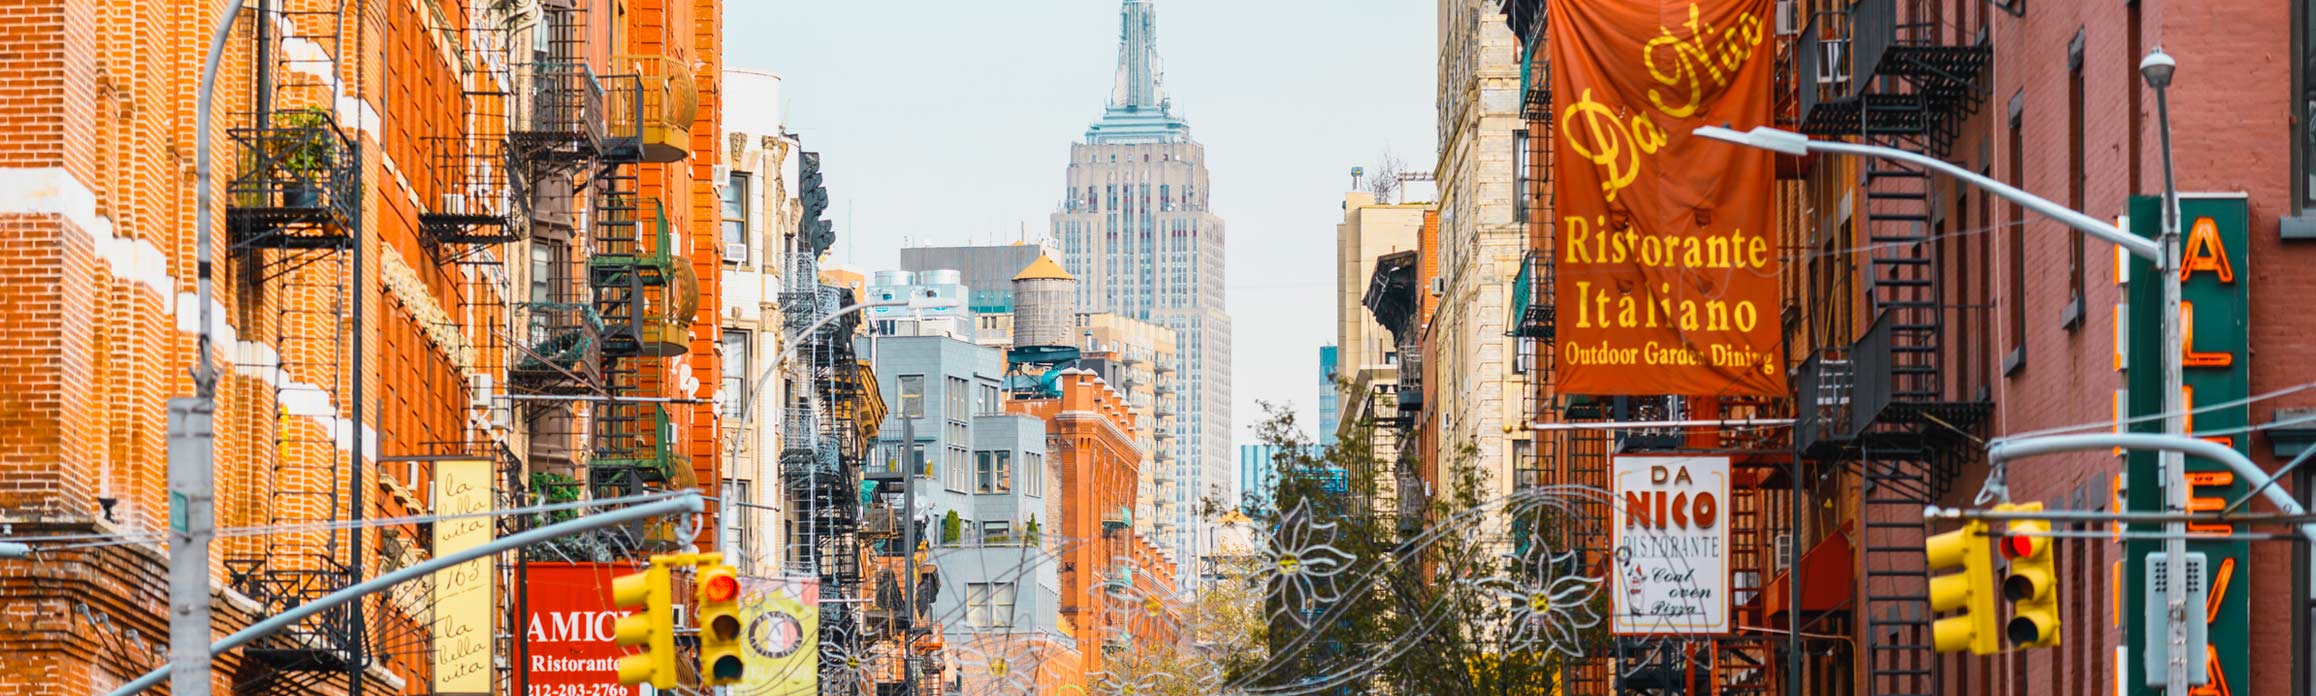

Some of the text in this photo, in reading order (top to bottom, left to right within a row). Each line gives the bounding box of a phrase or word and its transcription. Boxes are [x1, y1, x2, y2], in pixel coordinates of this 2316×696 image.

[1562, 2, 1763, 203] Da Nico
[1564, 215, 1768, 269] Ristorante
[1576, 280, 1758, 333] Italiano
[1565, 340, 1638, 366] Outdoor
[1711, 343, 1775, 375] Dining
[444, 473, 473, 497] la
[1651, 465, 1693, 486] DA
[1625, 490, 1717, 530] NICO
[442, 518, 486, 541] vita
[1623, 536, 1720, 559] RISTORANTE
[1651, 567, 1696, 583] Coal
[1650, 600, 1697, 618] Pizza
[443, 614, 473, 639] la
[527, 611, 632, 642] AMIC
[439, 636, 487, 666] bella
[442, 660, 487, 684] vita
[531, 655, 620, 672] Ristorante
